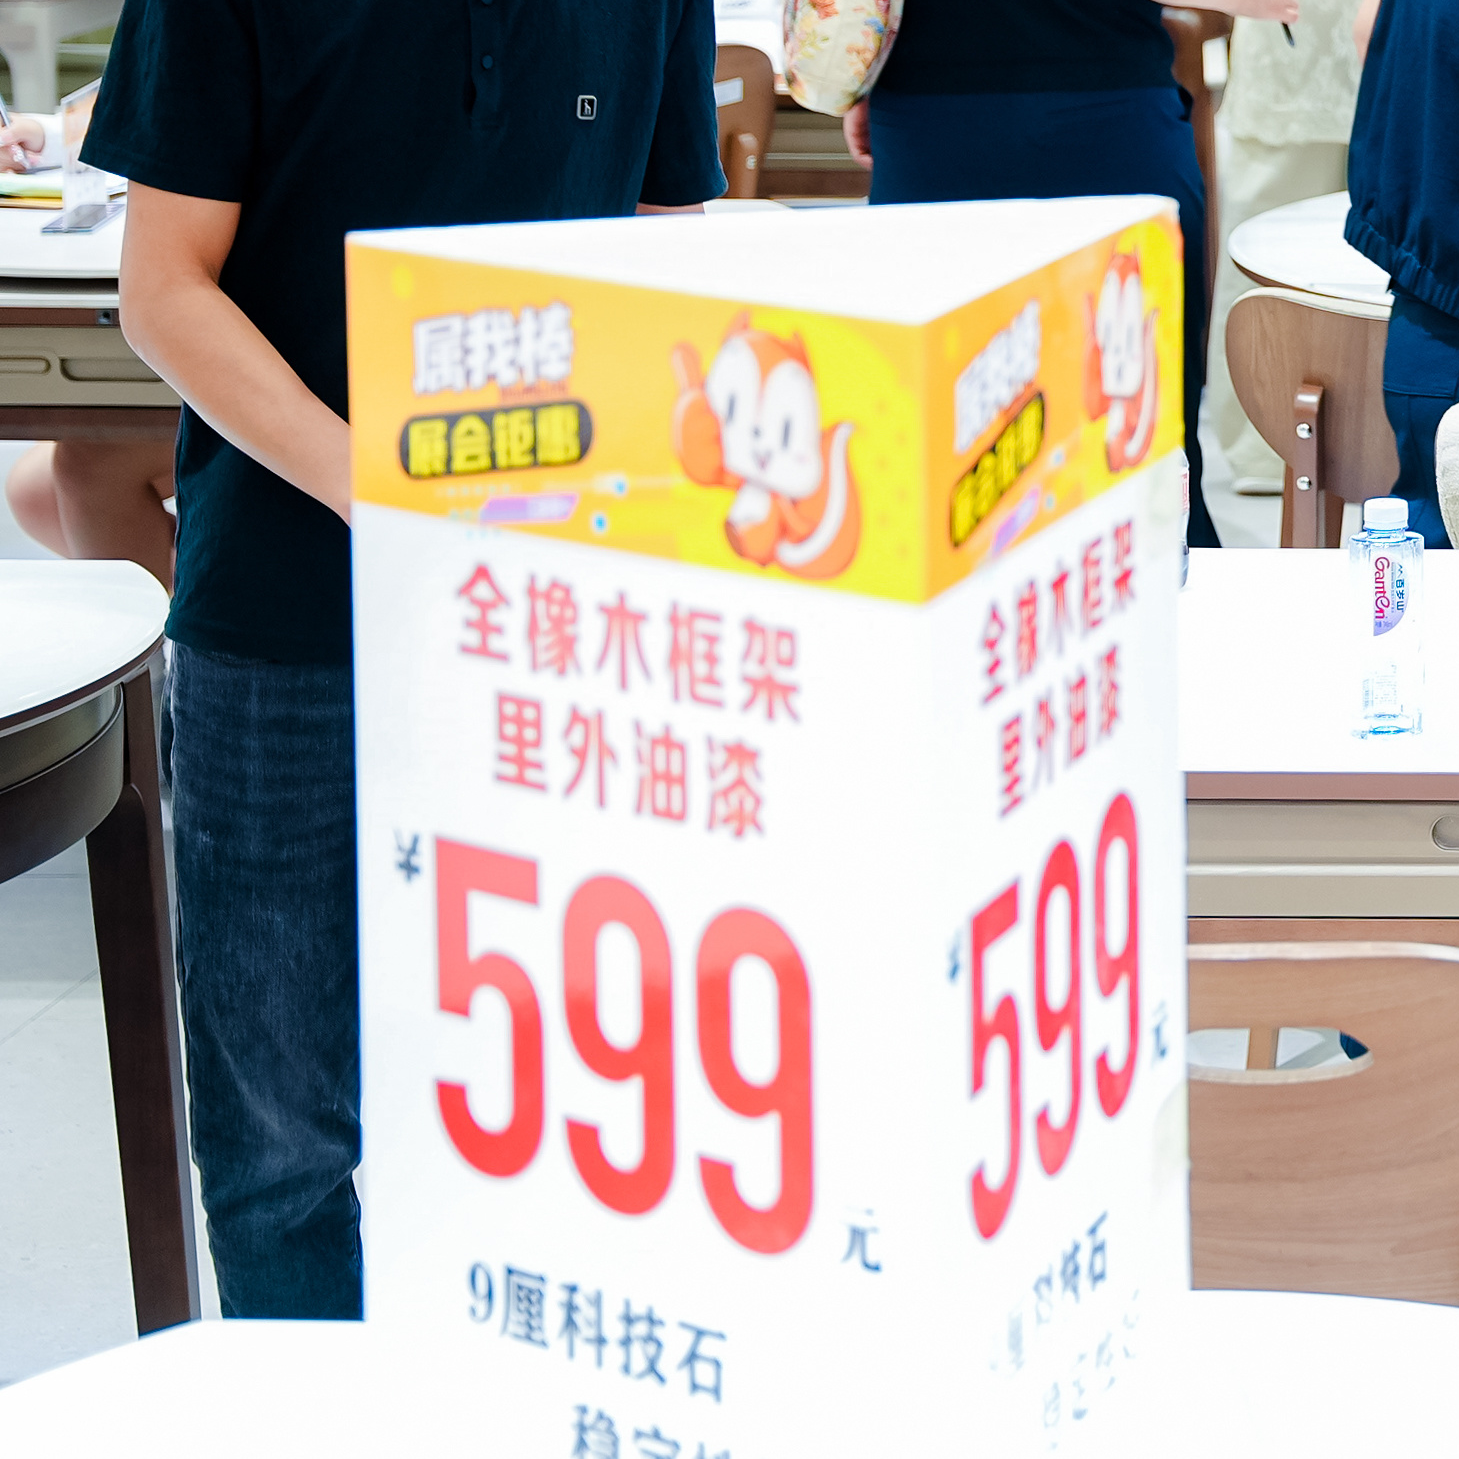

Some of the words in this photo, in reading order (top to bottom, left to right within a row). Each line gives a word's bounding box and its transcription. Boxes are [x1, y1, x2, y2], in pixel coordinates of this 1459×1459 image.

[412, 301, 574, 397] 属我棒
[457, 562, 802, 725] 全橡木框架
[494, 689, 766, 841] 里外油漆
[467, 1261, 728, 1405] 9厘科技石
